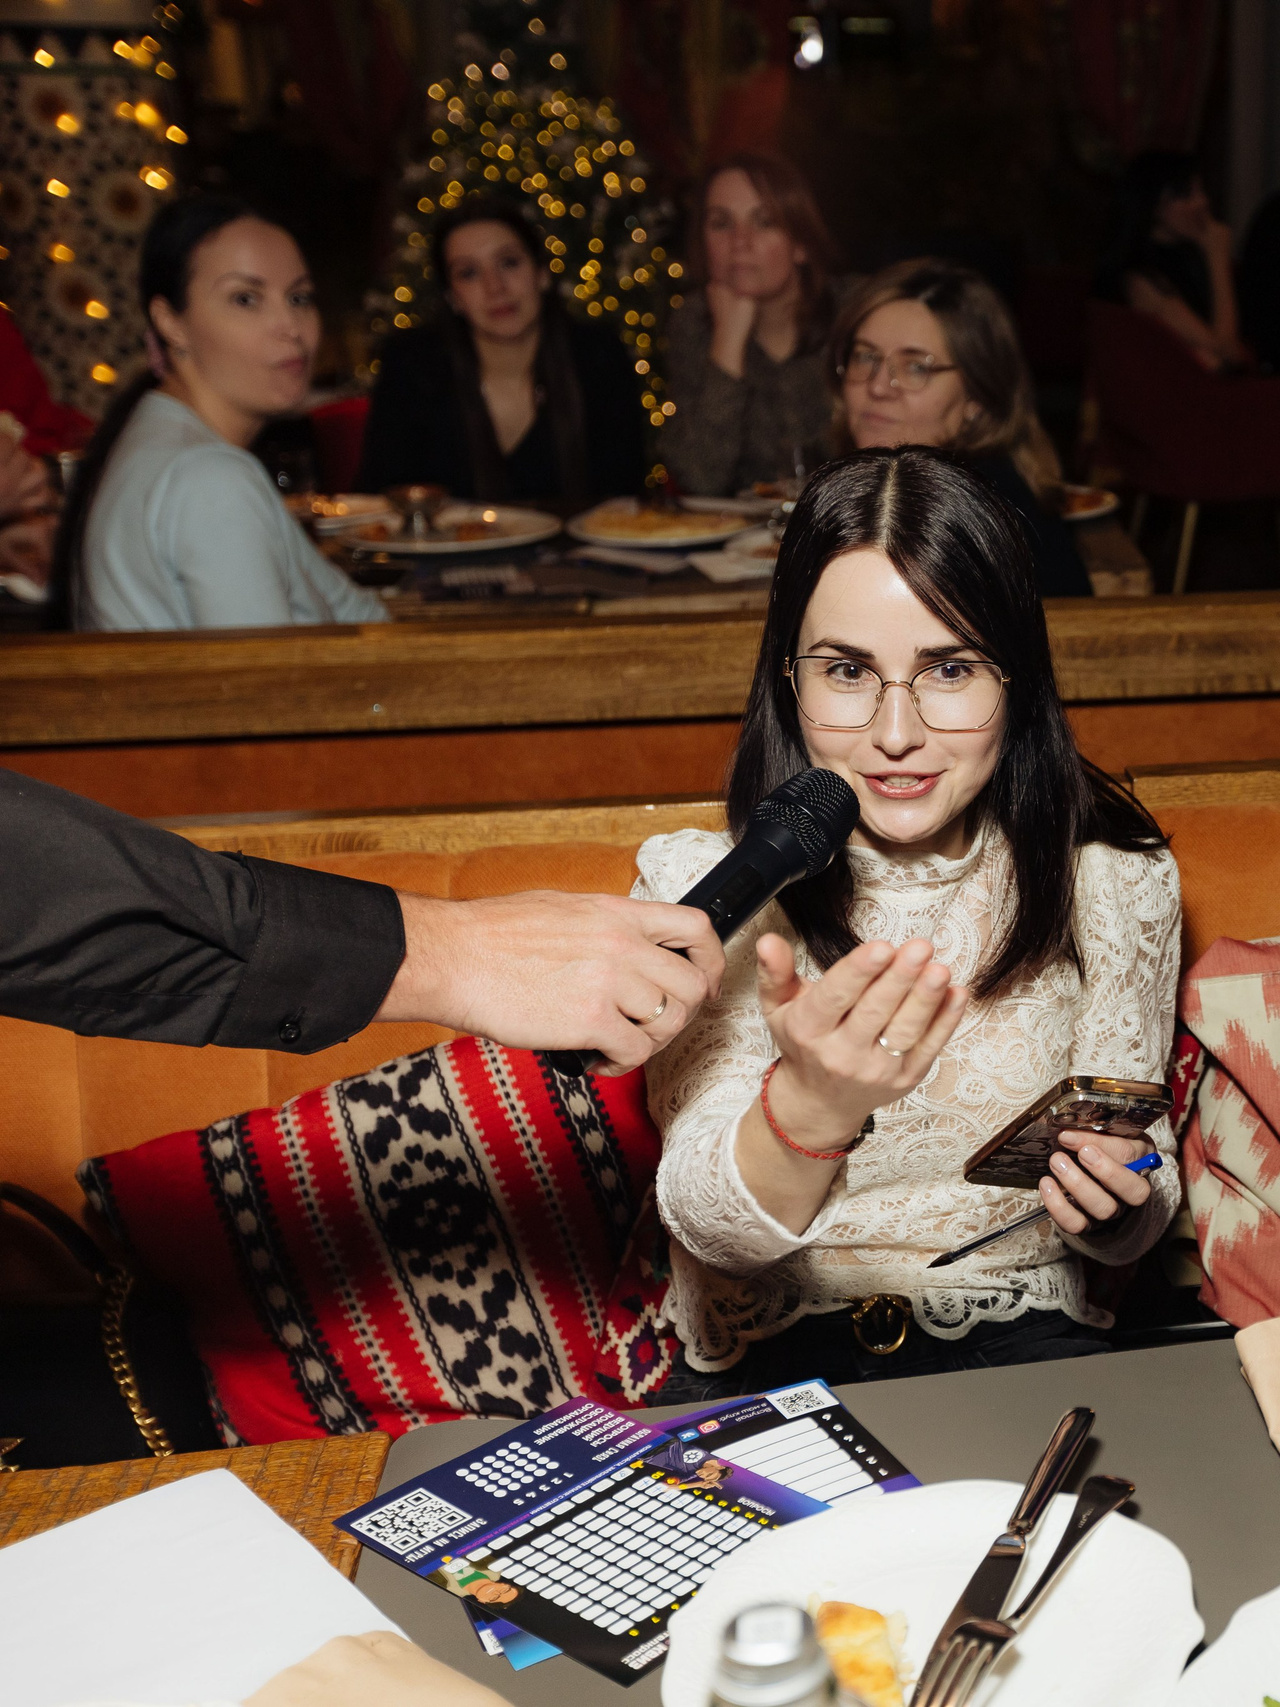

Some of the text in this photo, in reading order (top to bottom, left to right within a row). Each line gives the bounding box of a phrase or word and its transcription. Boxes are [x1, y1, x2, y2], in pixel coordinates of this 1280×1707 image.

[533, 1402, 595, 1436] ОРГАНИЗАЦИЯ
[533, 1407, 605, 1446] ОБСЛУЖИВАНИЕ
[571, 1411, 615, 1437] ЛОКАЦИЯ
[581, 1416, 626, 1442] ВЕДУЩИЙ
[734, 1407, 773, 1422] Вступай
[589, 1421, 636, 1448] ВОПРОСЫ
[512, 1471, 575, 1506] 1 2 3 4 5
[737, 1496, 777, 1517] ВОПРОСЫ
[404, 1517, 488, 1564] ЗАПИСЬ НА ИГРЫ:
[620, 1631, 671, 1665] телкросс
[628, 1642, 669, 1671] КВИЗ
